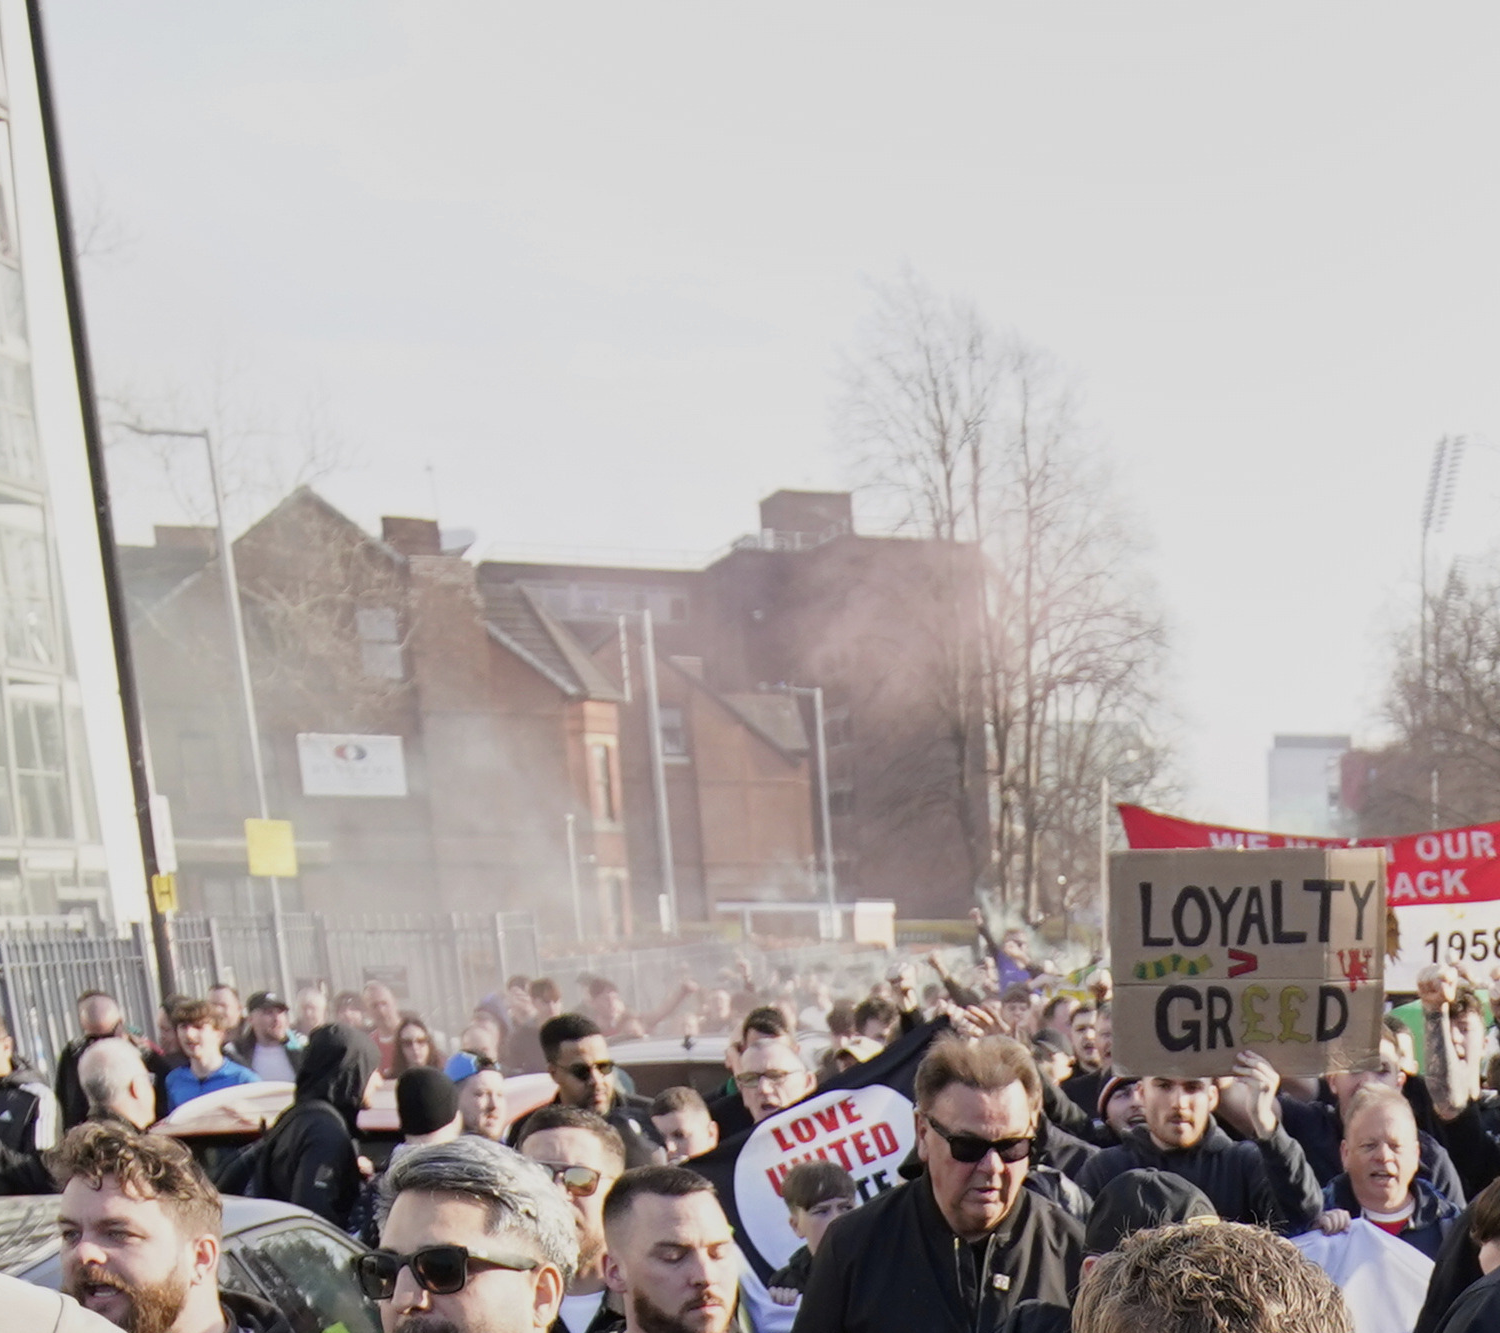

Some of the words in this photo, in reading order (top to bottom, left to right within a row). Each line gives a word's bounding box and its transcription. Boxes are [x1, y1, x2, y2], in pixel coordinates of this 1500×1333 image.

[1415, 830, 1497, 861] OUR
[1386, 869, 1469, 899] ACK
[1139, 879, 1376, 947] LOYALTY
[771, 1096, 863, 1152] LOVE
